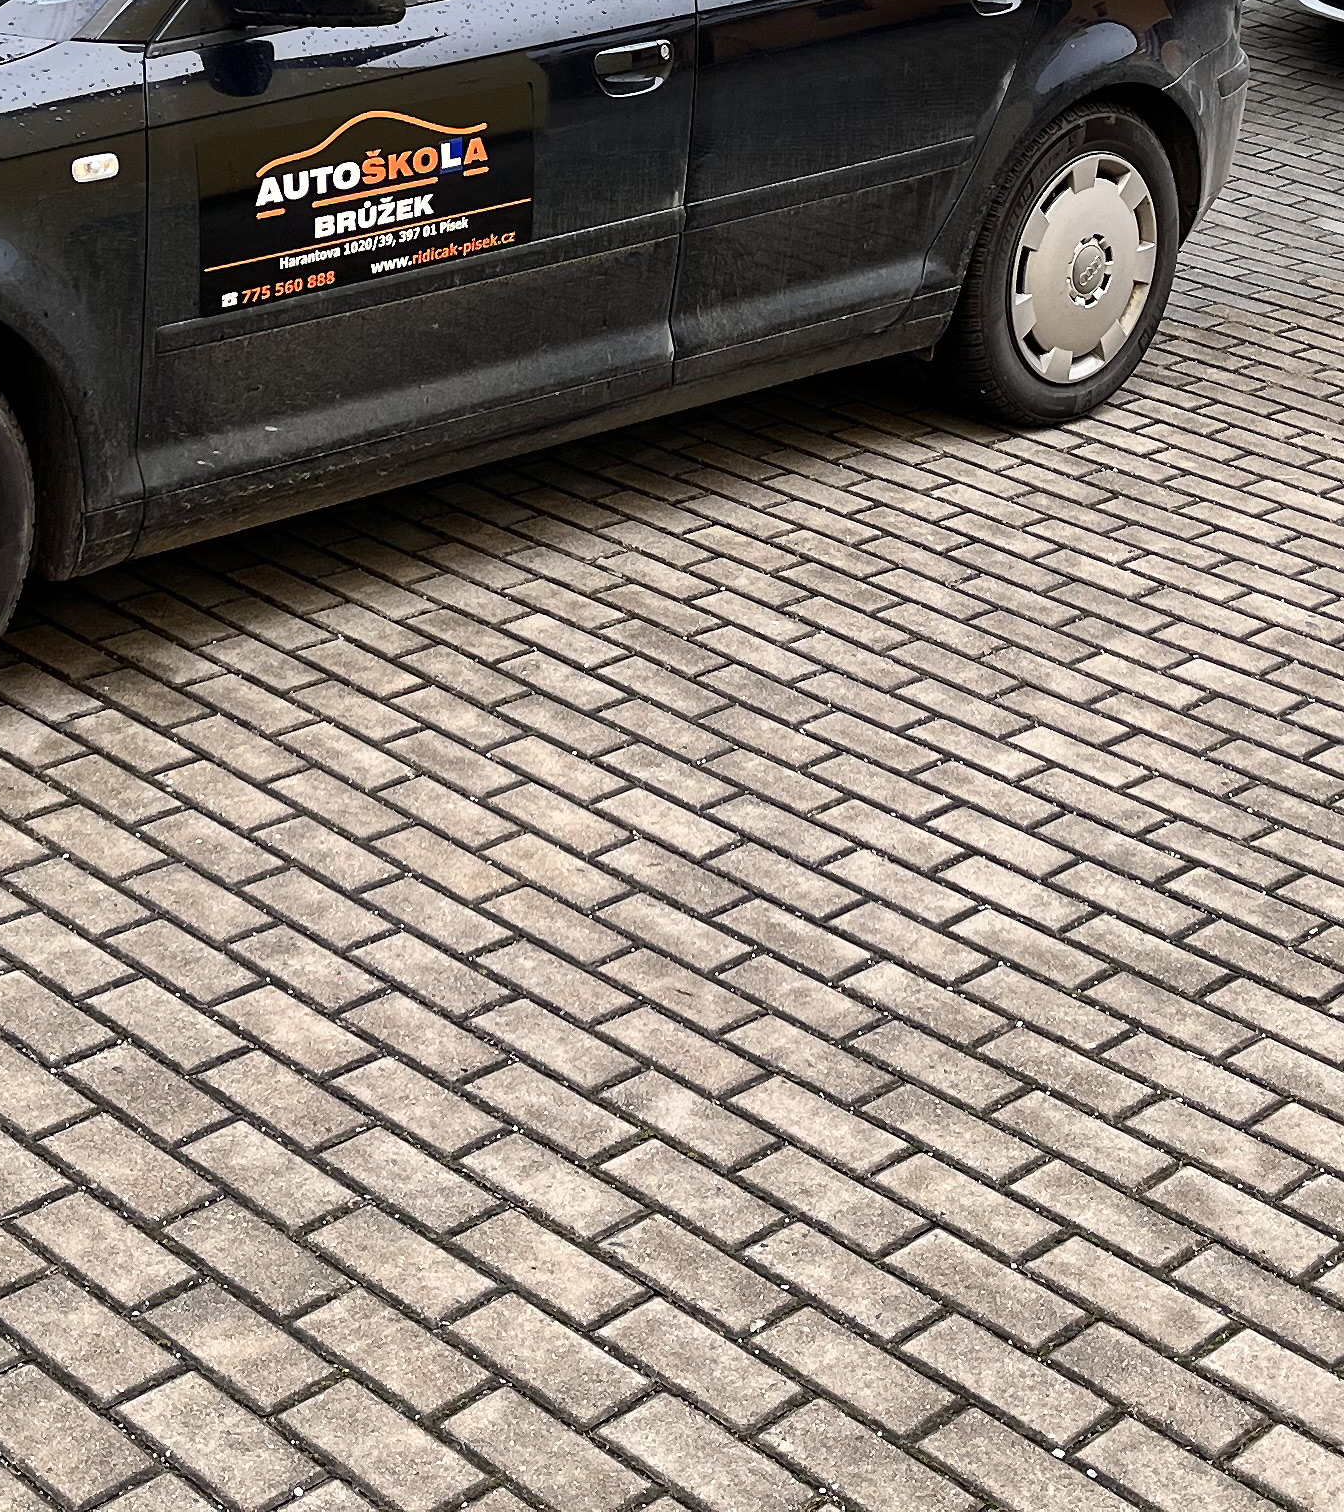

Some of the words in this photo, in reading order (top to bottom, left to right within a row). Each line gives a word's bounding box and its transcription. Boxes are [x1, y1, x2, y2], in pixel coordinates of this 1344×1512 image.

[255, 137, 488, 207] AUTOŠKOLA
[314, 193, 435, 239] BRŮŽEK
[279, 246, 342, 270] Harantova
[343, 233, 397, 256] 1020/39,
[398, 227, 420, 243] 397
[422, 224, 437, 237] 01
[439, 217, 470, 234] Písek
[370, 231, 516, 274] www.ridicak-pisek.cz
[241, 285, 271, 305] 775
[274, 278, 303, 297] 560
[307, 271, 336, 290] 888
